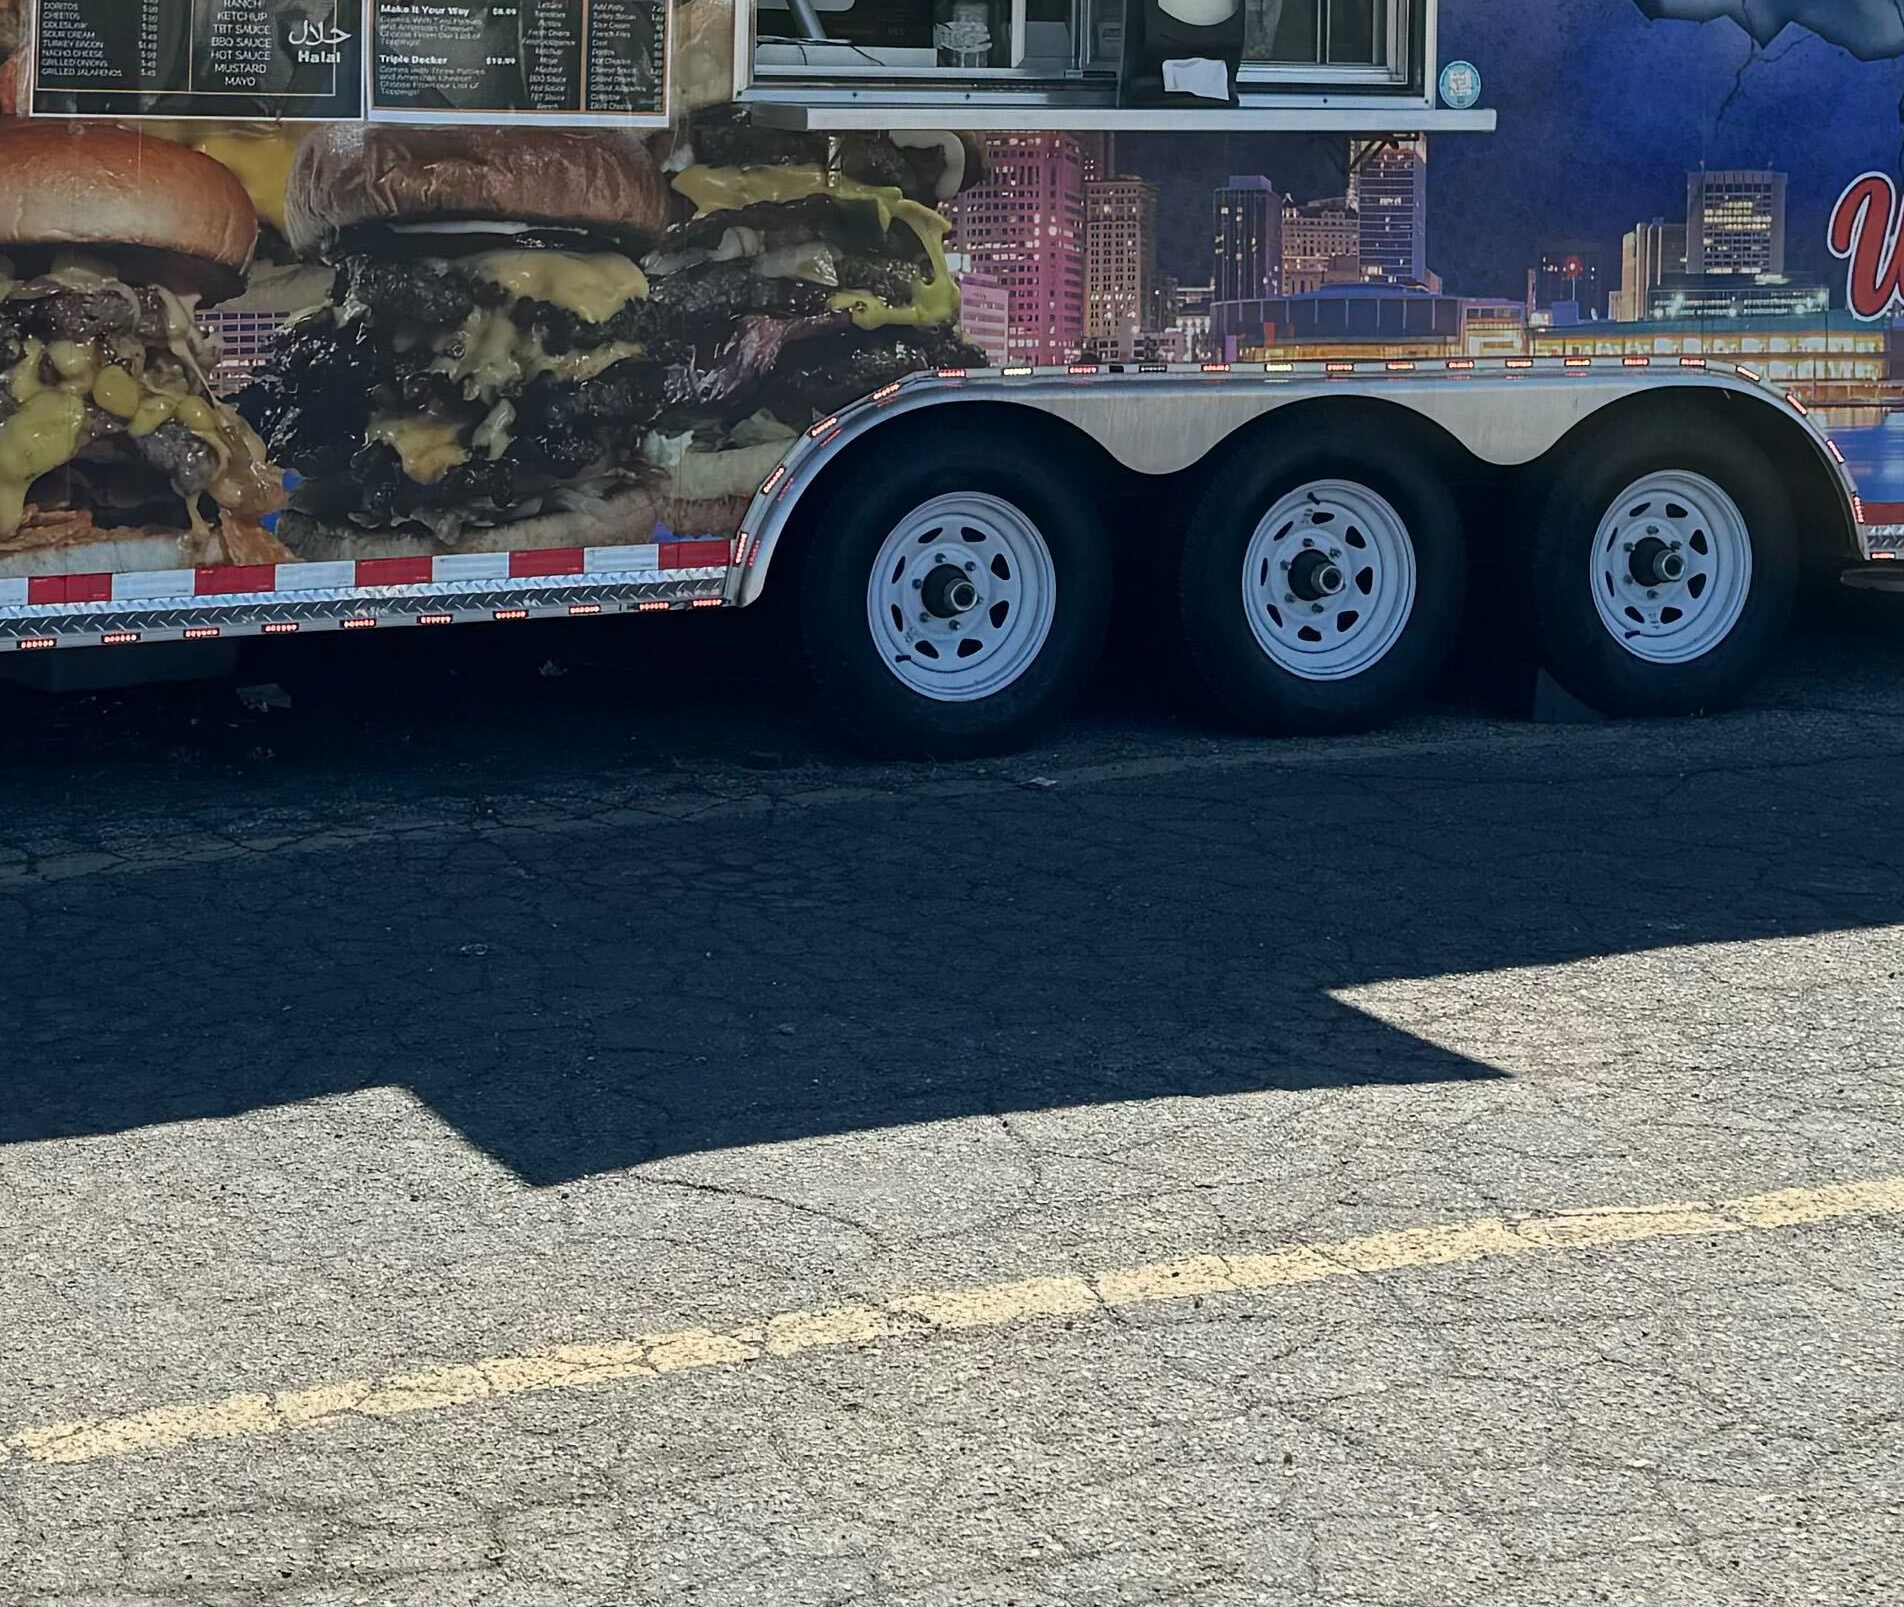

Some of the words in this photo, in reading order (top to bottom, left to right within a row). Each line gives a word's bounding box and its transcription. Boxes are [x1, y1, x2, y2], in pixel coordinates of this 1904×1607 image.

[44, 2, 78, 11] DORITOS
[380, 4, 409, 14] Make
[411, 5, 420, 14] It
[422, 6, 445, 15] Your
[447, 7, 470, 17] Way
[217, 11, 268, 21] KETCHUP
[213, 24, 233, 34] TBT
[235, 24, 271, 35] SAUCE
[288, 20, 352, 46] حلال
[67, 31, 95, 39] CREAM
[43, 40, 74, 48] TURKEY
[76, 40, 104, 48] BACON
[211, 37, 233, 47] BBQ
[236, 38, 272, 48] SAUCE
[211, 50, 232, 59] HOT
[235, 50, 271, 61] SAUCE
[298, 50, 341, 63] Halal
[379, 55, 409, 65] Triple
[411, 55, 447, 65] Decker
[42, 68, 75, 76] GRILLED
[214, 63, 267, 74] MUSTARD
[225, 77, 256, 86] MAYO
